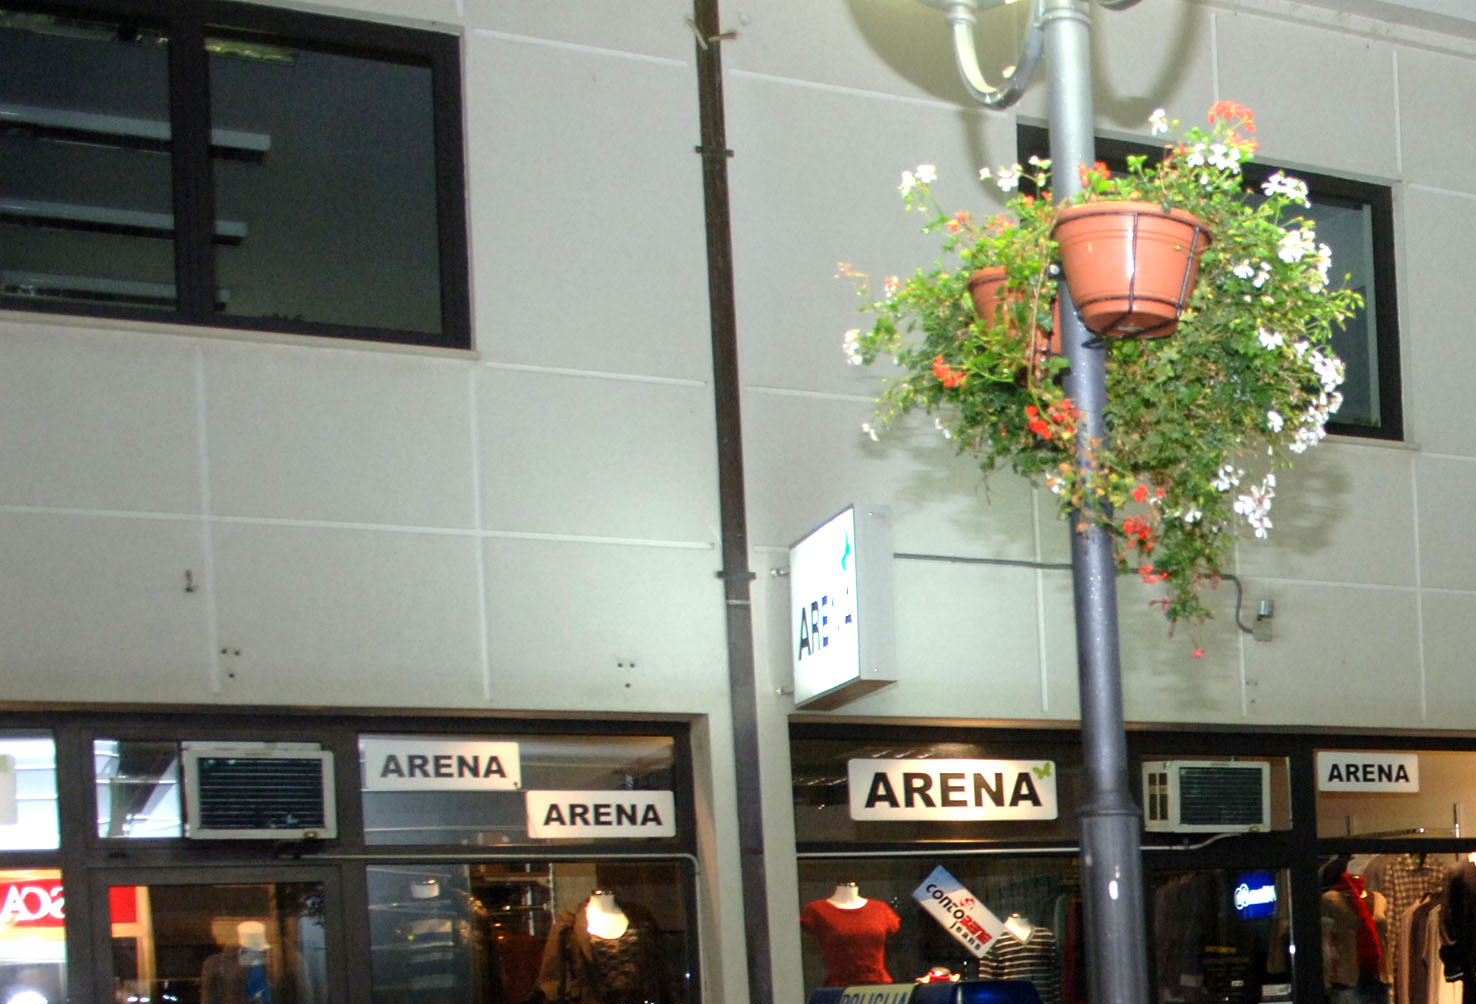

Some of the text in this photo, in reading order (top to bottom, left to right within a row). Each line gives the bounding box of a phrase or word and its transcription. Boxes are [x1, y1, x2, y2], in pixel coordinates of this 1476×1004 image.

[380, 754, 508, 778] ARENA
[1328, 763, 1410, 783] ARENA
[864, 772, 1043, 808] ARENA
[543, 803, 663, 826] ARENA
